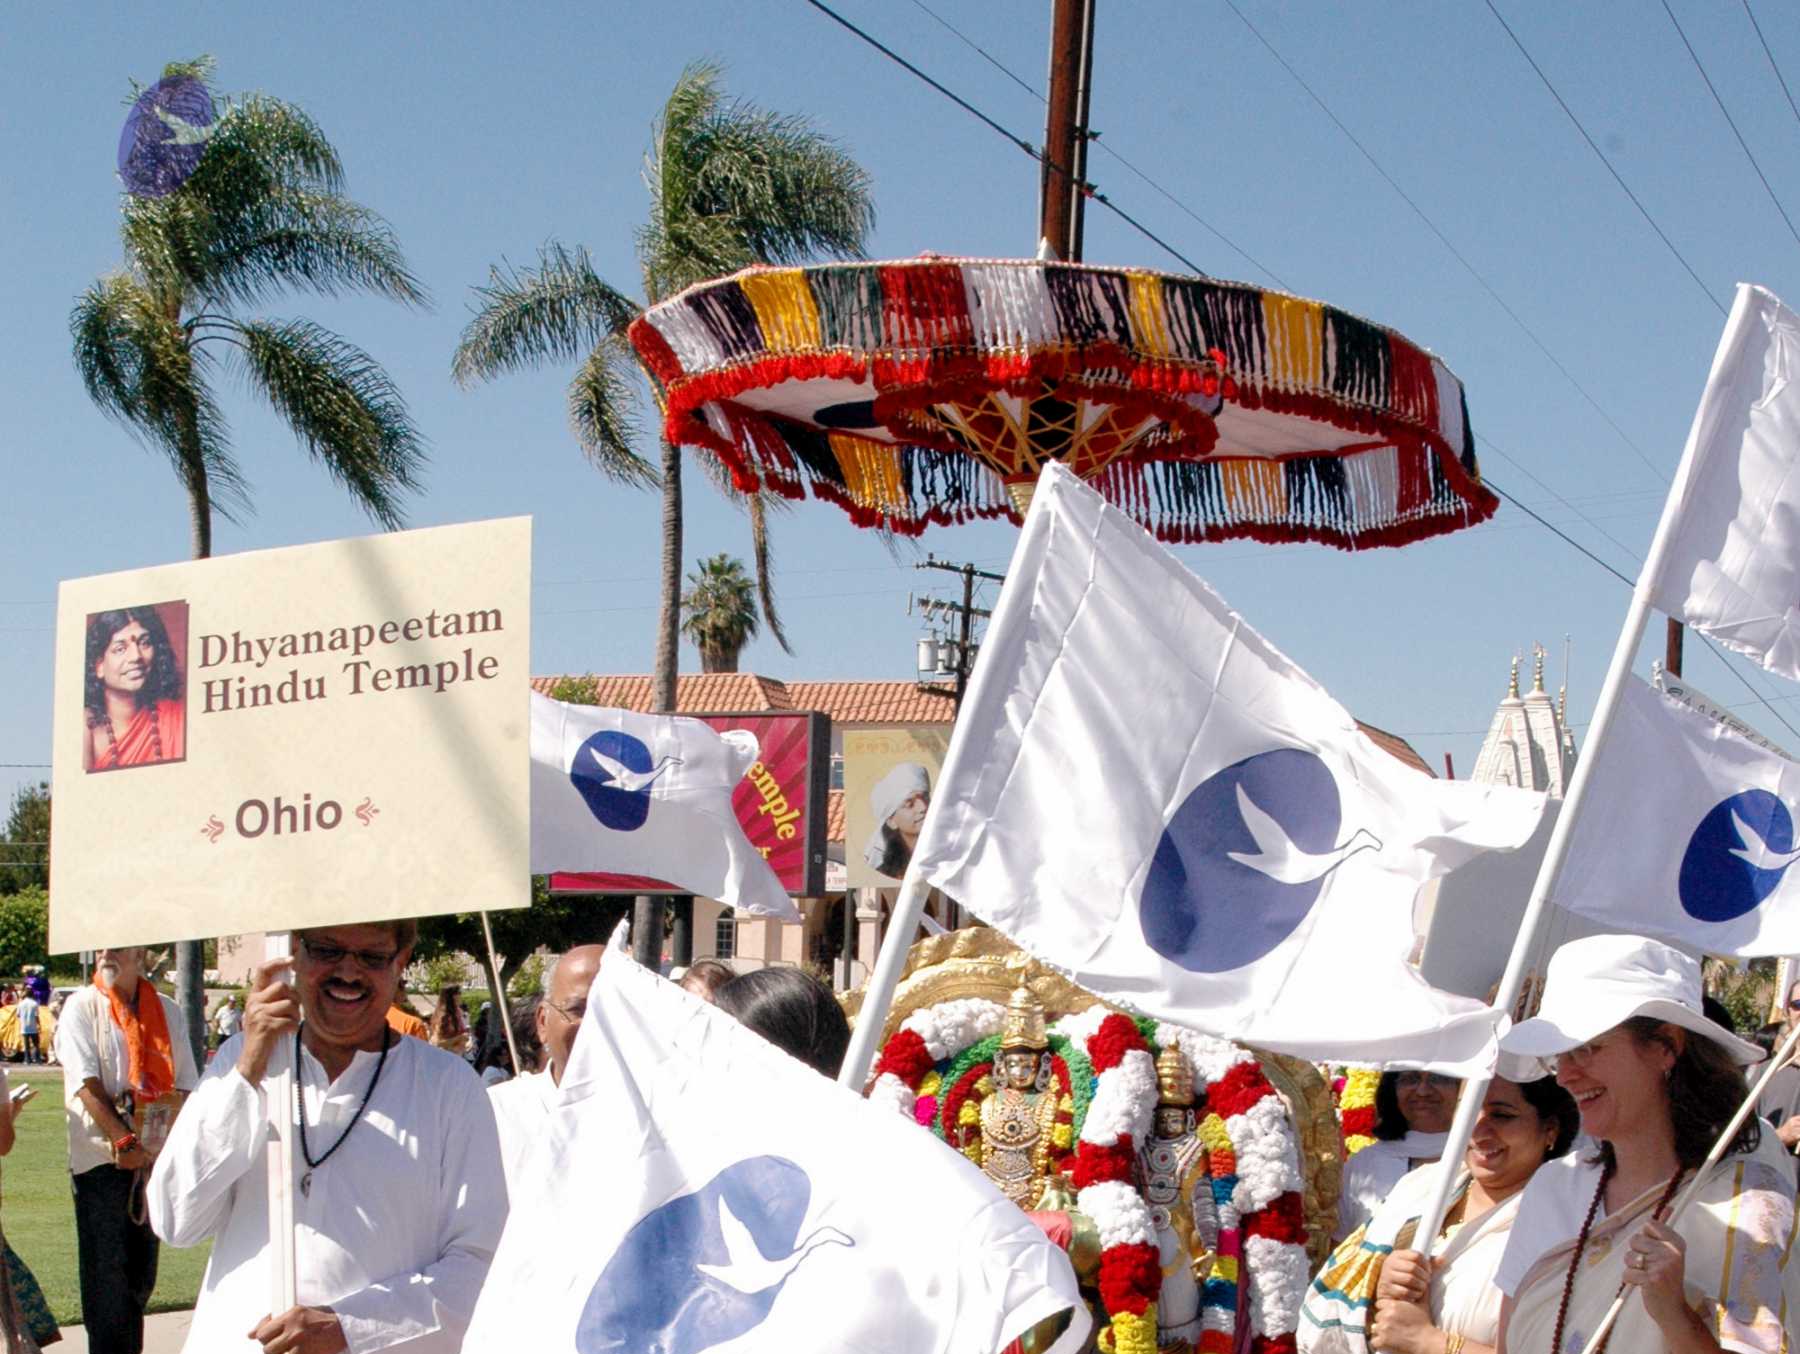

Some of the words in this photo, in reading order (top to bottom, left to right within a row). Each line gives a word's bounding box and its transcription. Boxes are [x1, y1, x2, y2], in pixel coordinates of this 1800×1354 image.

[198, 608, 504, 668] Dhyanapeetam
[202, 669, 327, 713] Hindu
[342, 648, 499, 694] Temple
[235, 793, 343, 838] Ohio
[746, 760, 801, 841] emple
